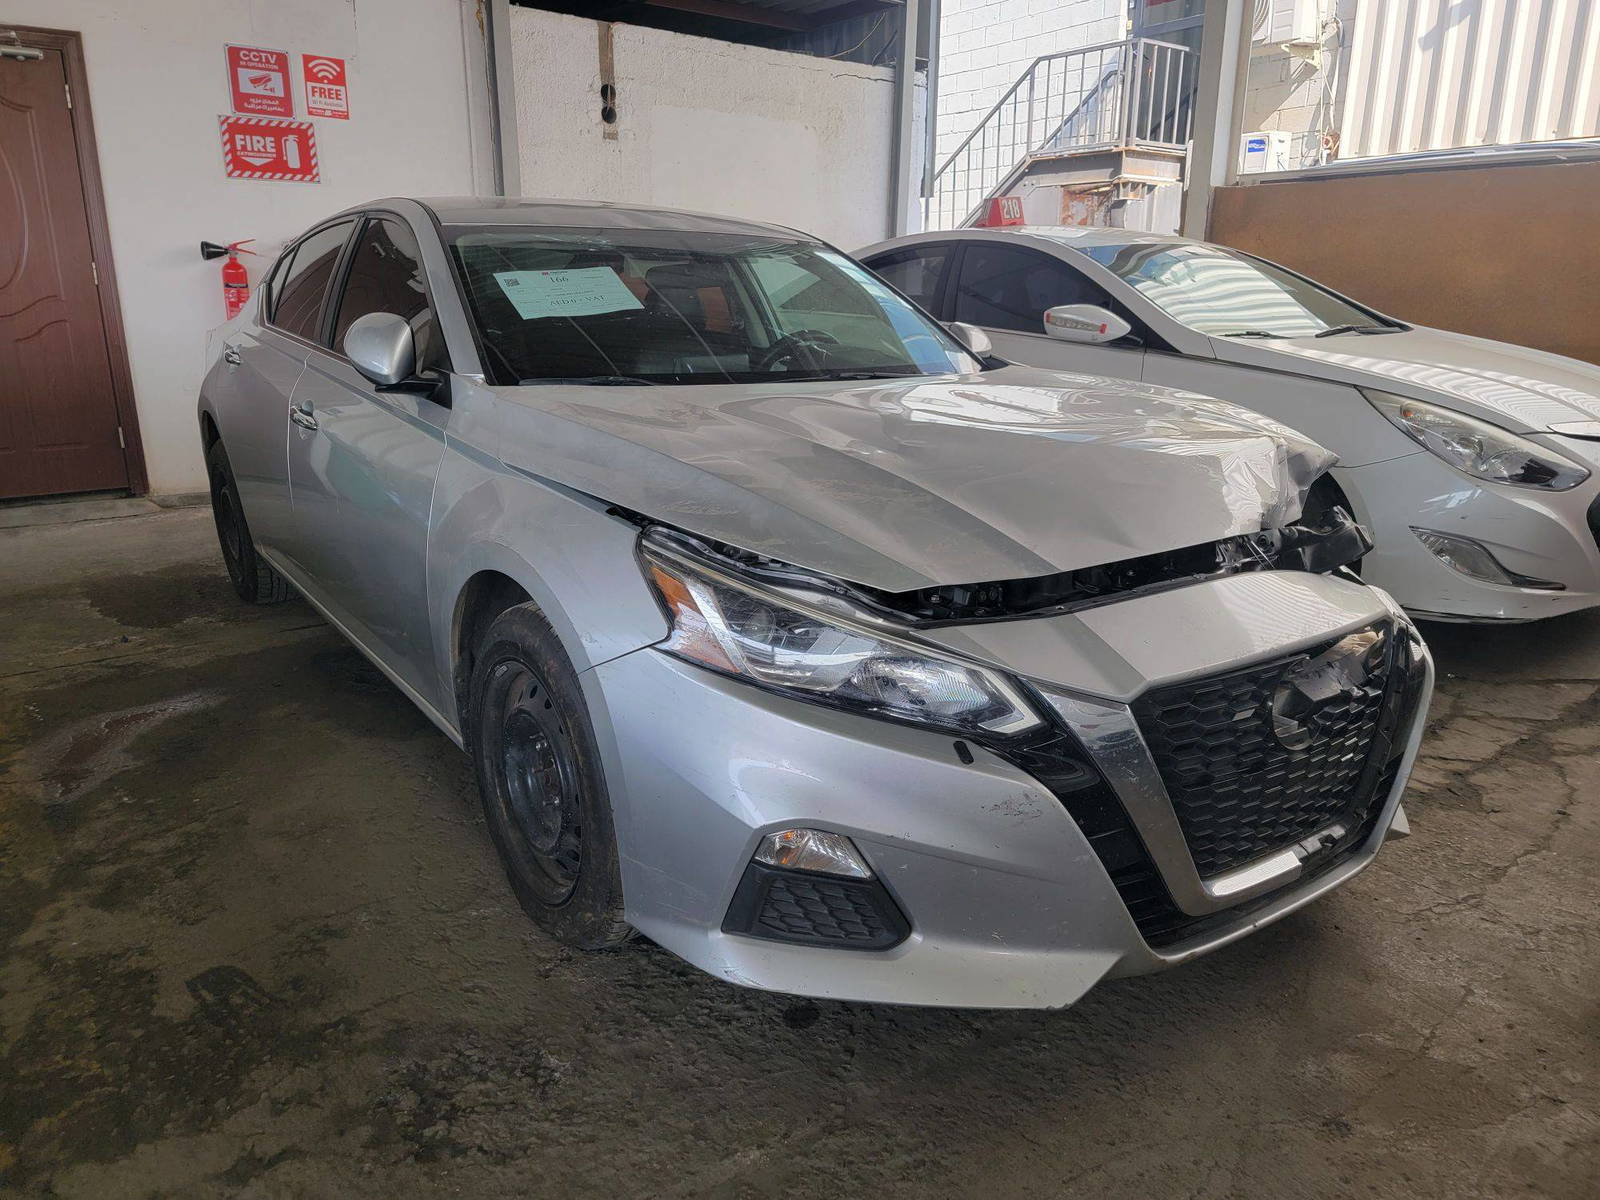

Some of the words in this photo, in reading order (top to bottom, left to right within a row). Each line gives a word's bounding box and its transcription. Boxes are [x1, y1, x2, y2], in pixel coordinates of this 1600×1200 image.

[240, 50, 276, 64] CCTV
[311, 86, 342, 100] FREE
[235, 134, 276, 152] FIRE
[1002, 199, 1020, 218] 218
